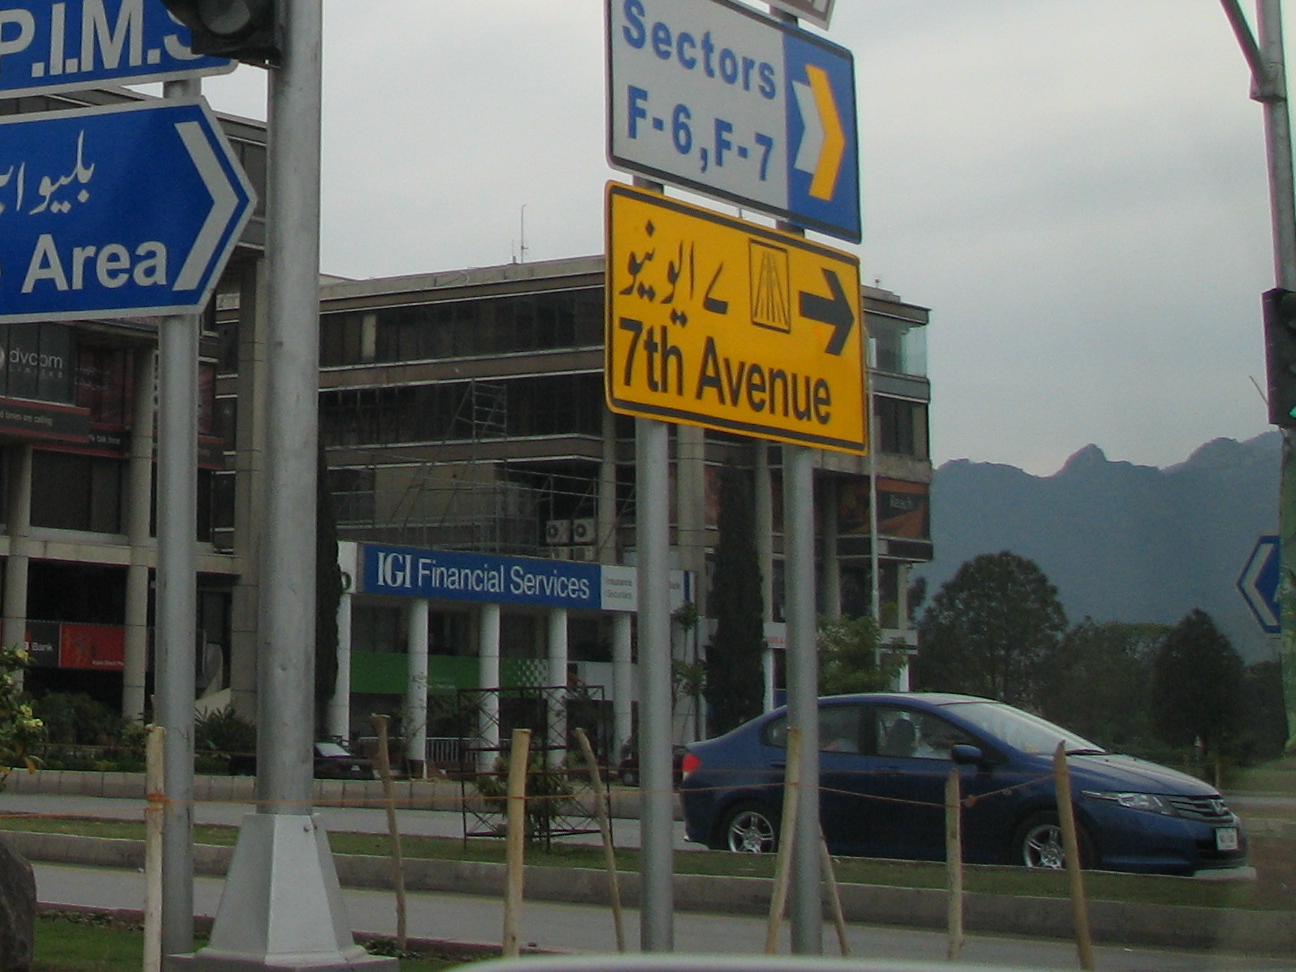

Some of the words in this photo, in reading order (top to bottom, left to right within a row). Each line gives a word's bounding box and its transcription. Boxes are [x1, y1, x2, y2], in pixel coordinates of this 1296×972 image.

[20, 233, 168, 294] Area
[618, 316, 684, 397] 7th
[695, 335, 832, 425] Avenue
[376, 551, 413, 589] IGI
[417, 557, 505, 594] Financial
[509, 565, 591, 600] Services
